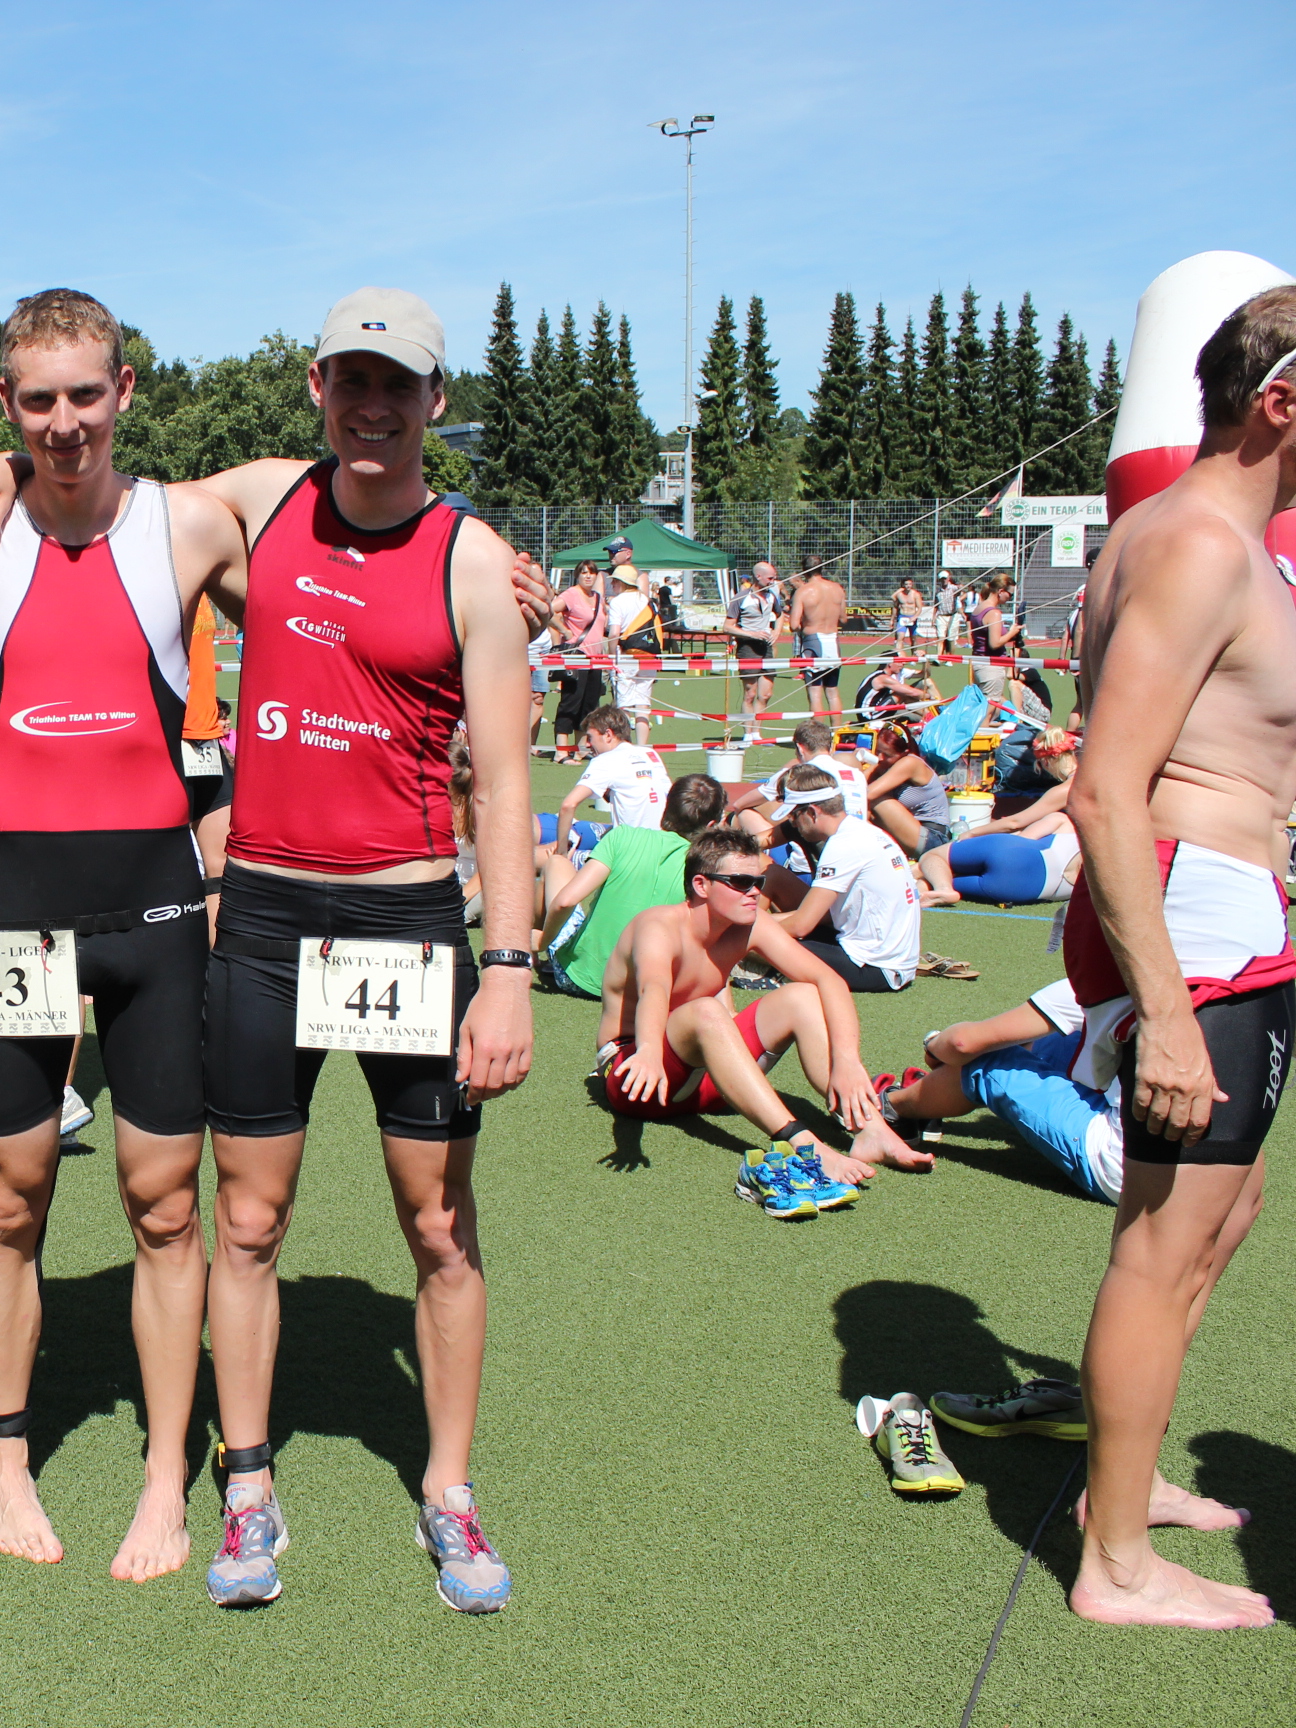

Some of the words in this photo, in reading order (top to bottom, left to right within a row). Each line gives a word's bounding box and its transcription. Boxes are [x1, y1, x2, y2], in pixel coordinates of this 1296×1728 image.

[1032, 506, 1047, 515] EIN
[1050, 506, 1077, 515] TEAM
[1087, 505, 1102, 515] EIN
[962, 543, 1010, 553] MEDITERRAN
[326, 552, 364, 571] skinfit
[29, 714, 66, 724] Triathlon
[69, 713, 93, 722] TEAM
[95, 712, 107, 720] TG
[109, 711, 136, 719] Witten
[301, 708, 392, 741] Stadtwerke
[299, 729, 351, 752] Witten
[198, 746, 212, 763] 35
[384, 958, 429, 970] LIGEN
[344, 978, 401, 1020] 44
[15, 1009, 68, 1020] MÄNNER
[307, 1022, 337, 1034] NRW
[340, 1024, 371, 1035] LIGA
[382, 1025, 438, 1038] MÄNNER
